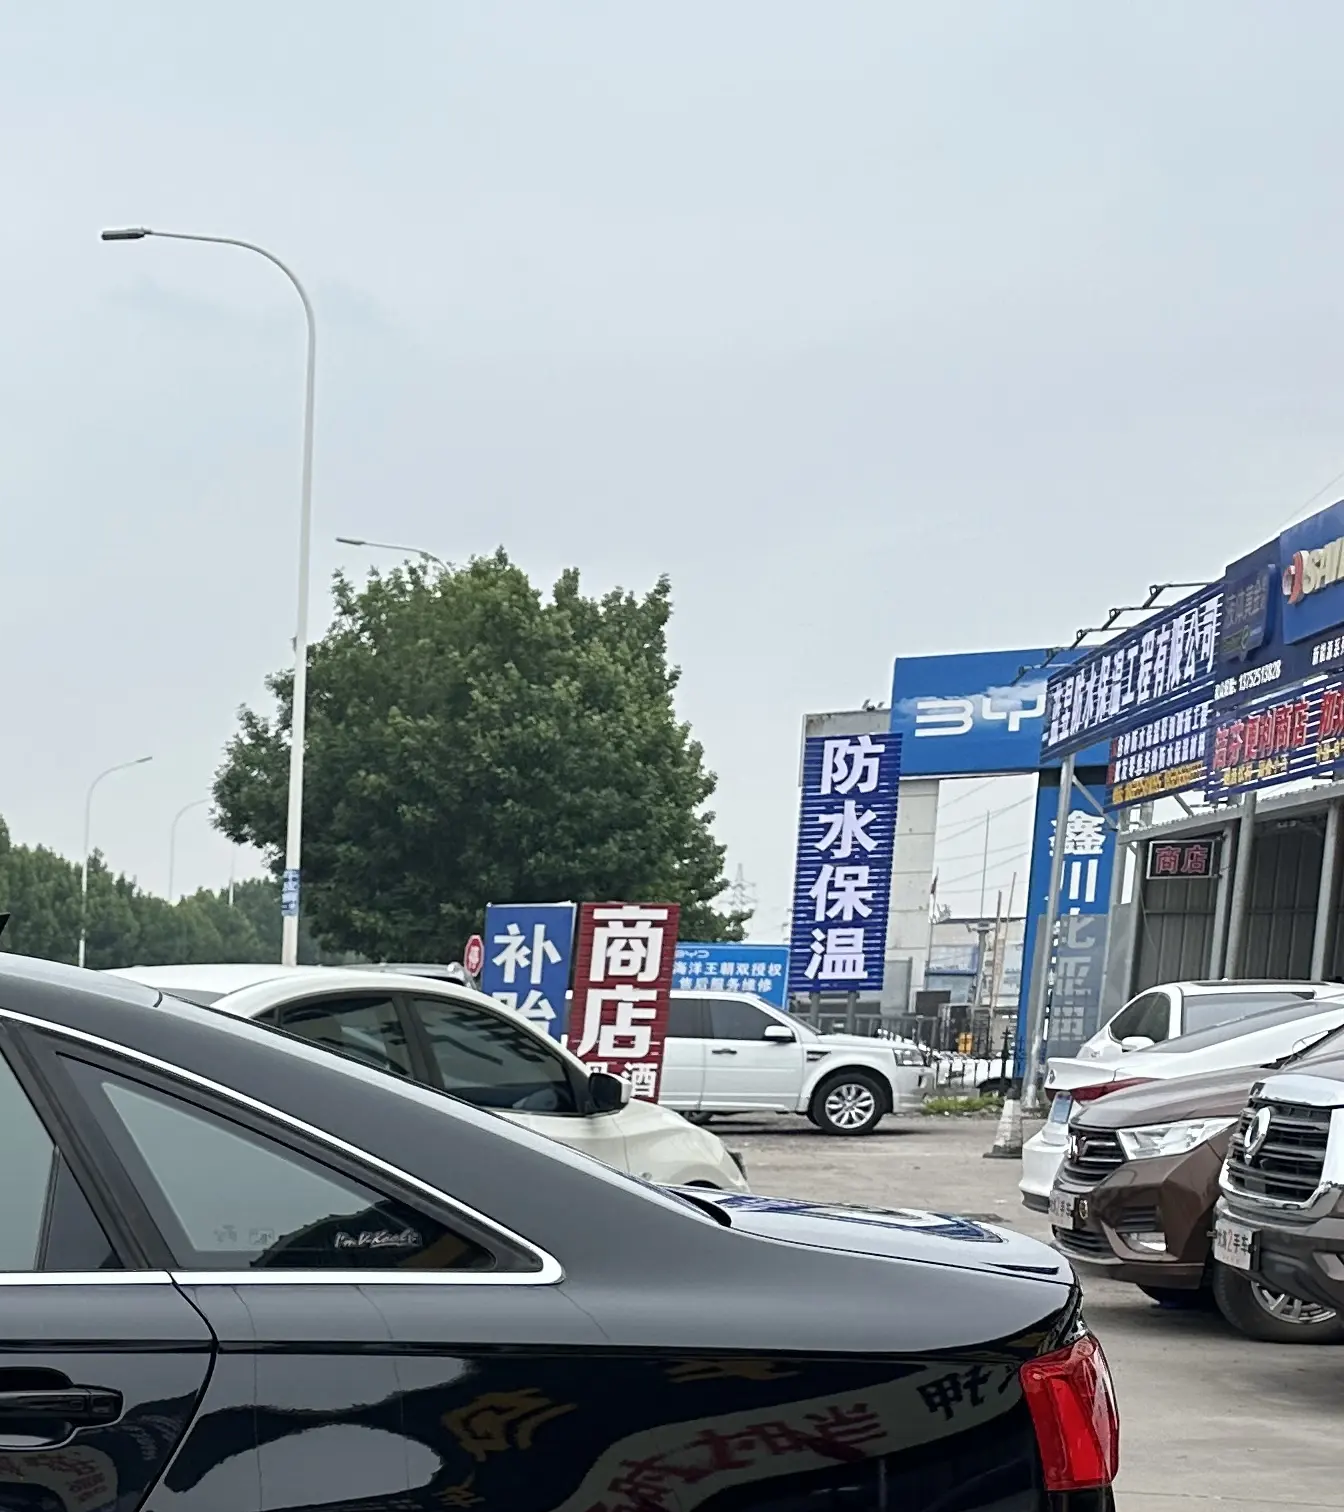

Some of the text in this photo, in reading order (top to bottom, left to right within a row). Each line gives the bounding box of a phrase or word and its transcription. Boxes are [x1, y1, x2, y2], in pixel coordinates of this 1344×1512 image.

[915, 694, 1047, 738] BY
[804, 735, 885, 980] 防水保温
[1155, 845, 1209, 874] 商店
[577, 906, 668, 1058] 商店
[585, 1061, 659, 1098] 酒
